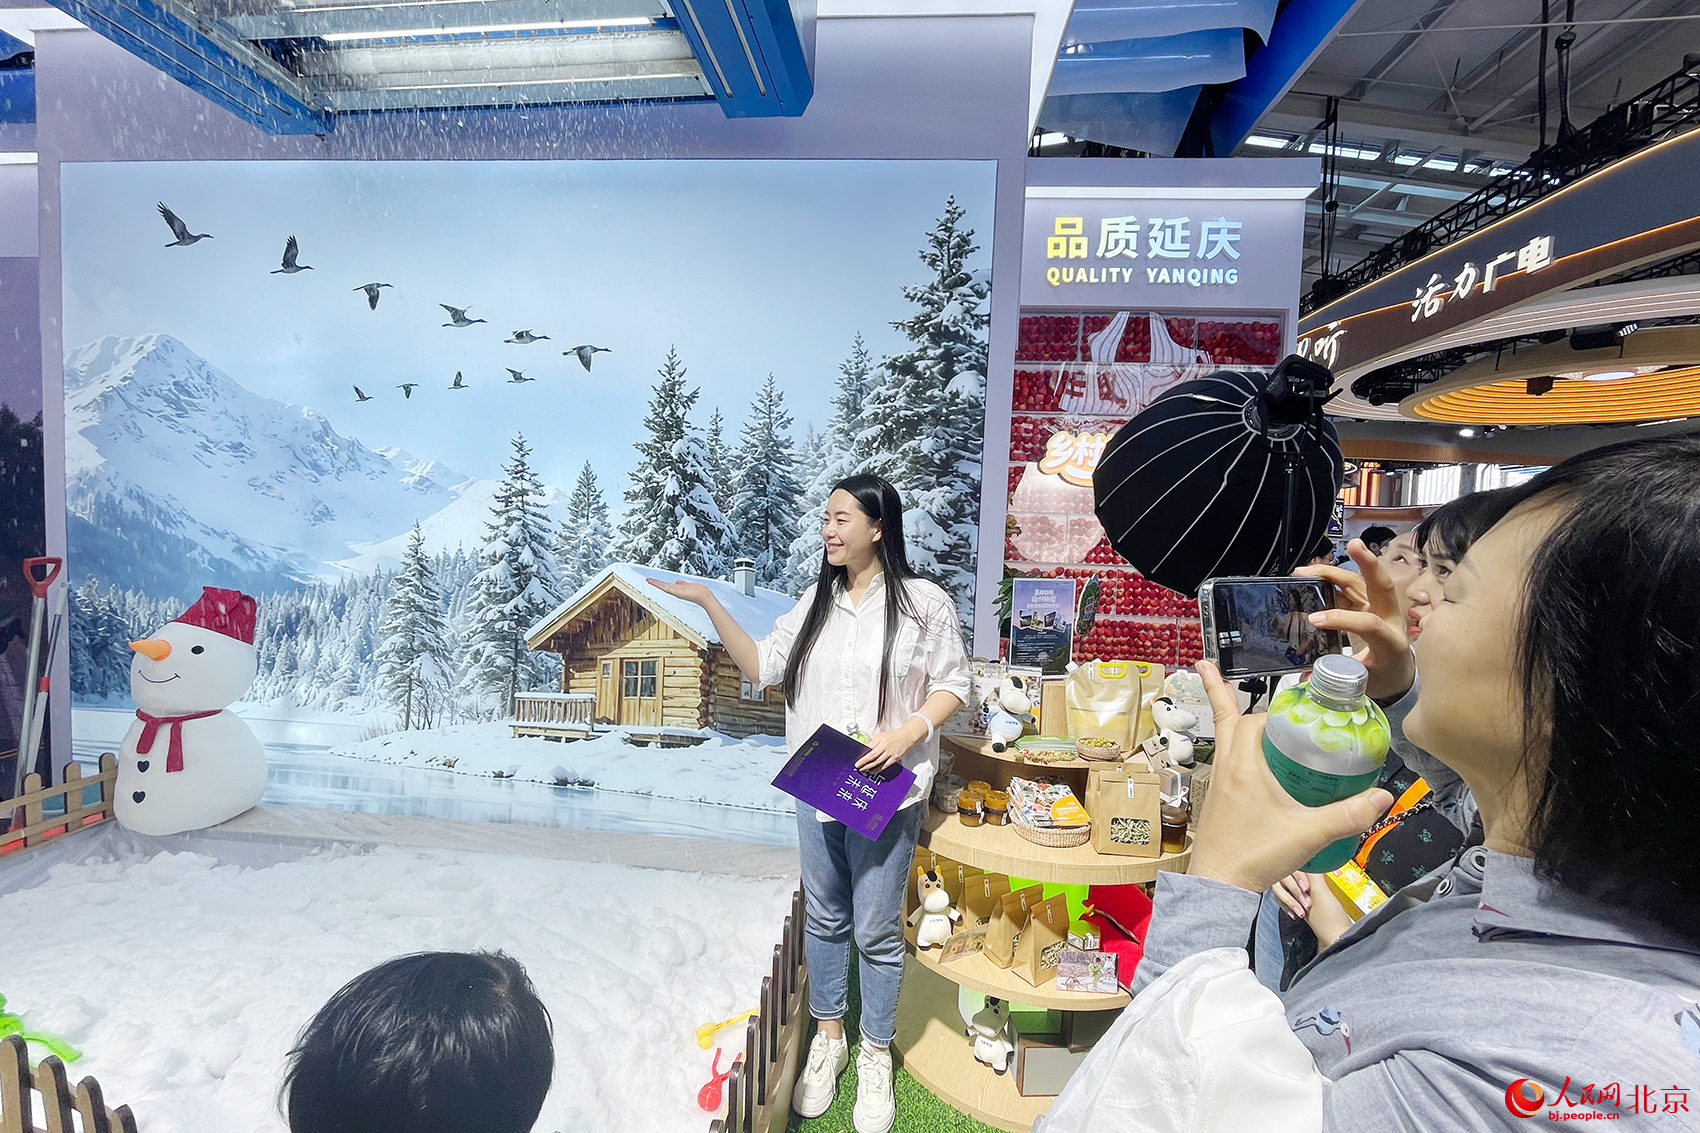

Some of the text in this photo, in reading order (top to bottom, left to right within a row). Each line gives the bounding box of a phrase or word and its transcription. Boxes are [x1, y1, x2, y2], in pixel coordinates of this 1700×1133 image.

[1047, 215, 1243, 261] 品质延庆
[1046, 267, 1239, 287] QUALITY YANQING
[1411, 235, 1553, 323] 活力广电
[1045, 434, 1106, 468] 乡村
[851, 773, 886, 811] 与延庆
